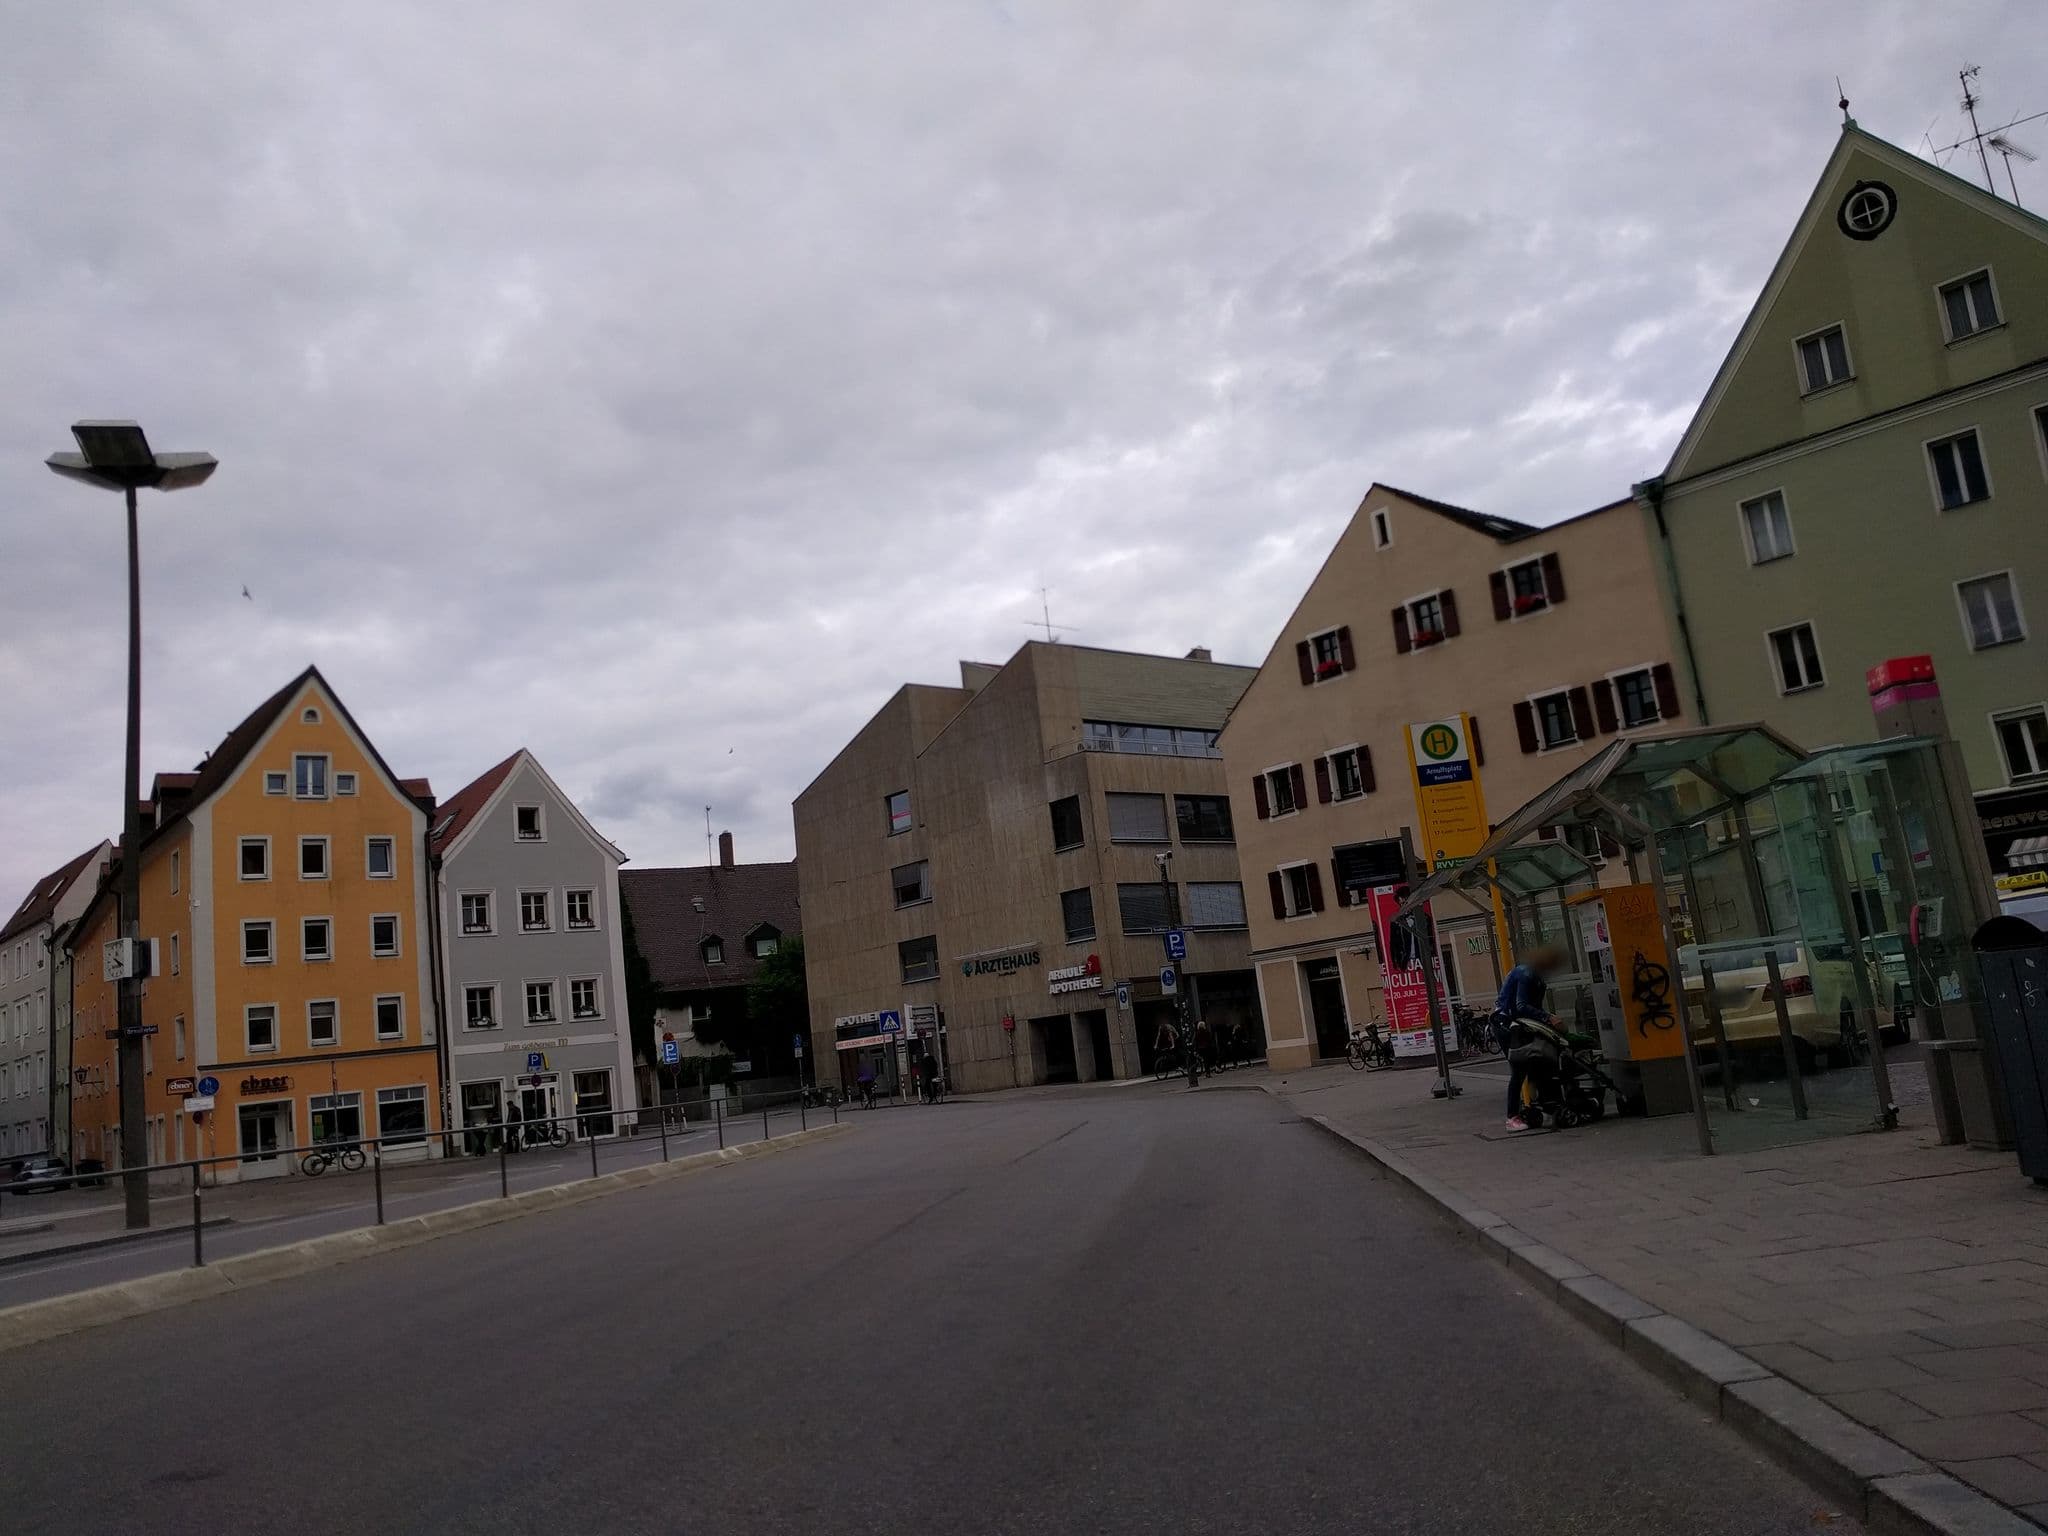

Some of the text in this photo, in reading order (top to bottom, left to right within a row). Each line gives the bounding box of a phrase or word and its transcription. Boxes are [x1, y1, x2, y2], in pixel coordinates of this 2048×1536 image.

[1436, 860, 1455, 870] RVV
[2002, 873, 2035, 885] TAXI
[1169, 934, 1181, 951] P
[974, 951, 1041, 976] ÄRZTEHAUS
[1407, 956, 1440, 971] JAIE
[1048, 965, 1087, 981] ARNULF
[1391, 969, 1442, 988] CULLM
[1049, 976, 1103, 995] APOTHEKE
[835, 1010, 880, 1028] APOTHE
[665, 1043, 675, 1057] P
[531, 1055, 539, 1065] P
